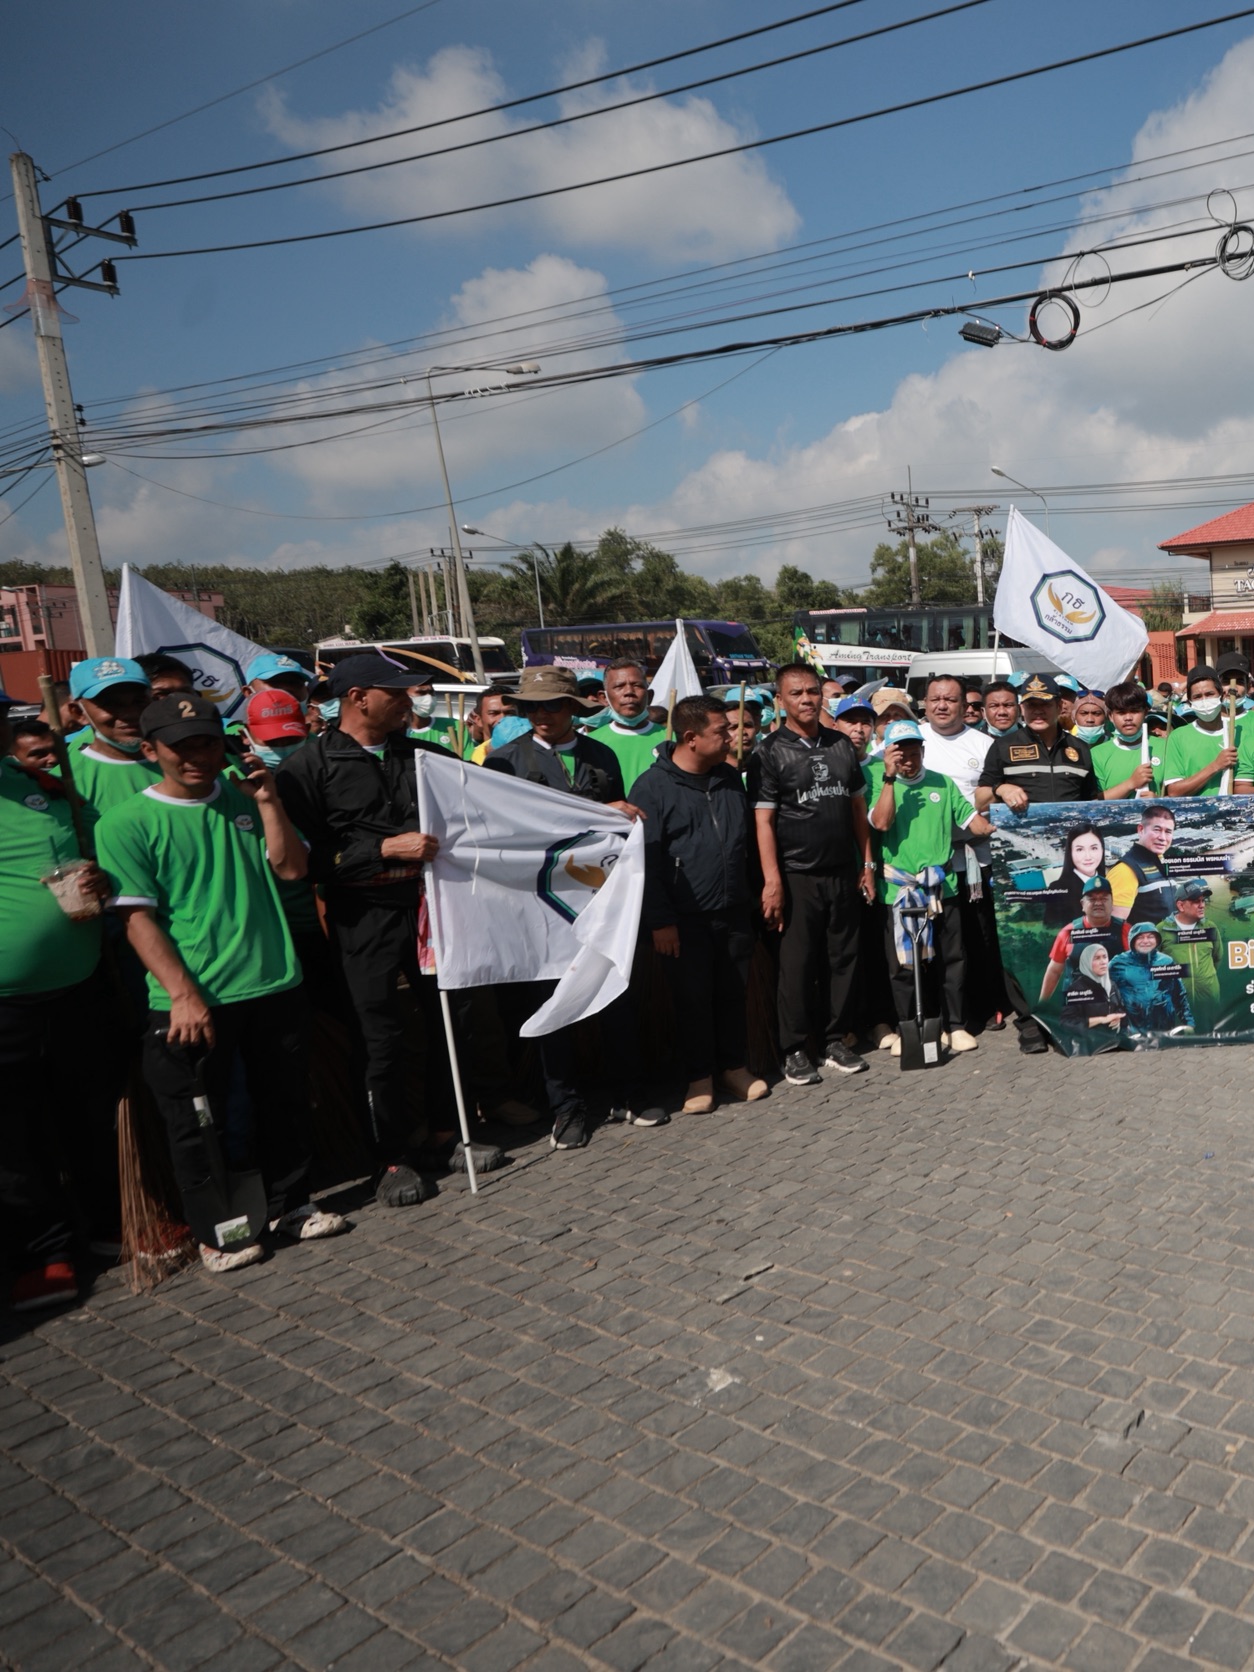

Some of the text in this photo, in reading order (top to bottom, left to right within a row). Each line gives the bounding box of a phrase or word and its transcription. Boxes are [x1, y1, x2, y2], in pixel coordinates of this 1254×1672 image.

[1061, 592, 1085, 609] กธ
[1044, 613, 1073, 635] กล้าธรรม
[863, 651, 912, 662] Transport
[178, 700, 196, 718] 2
